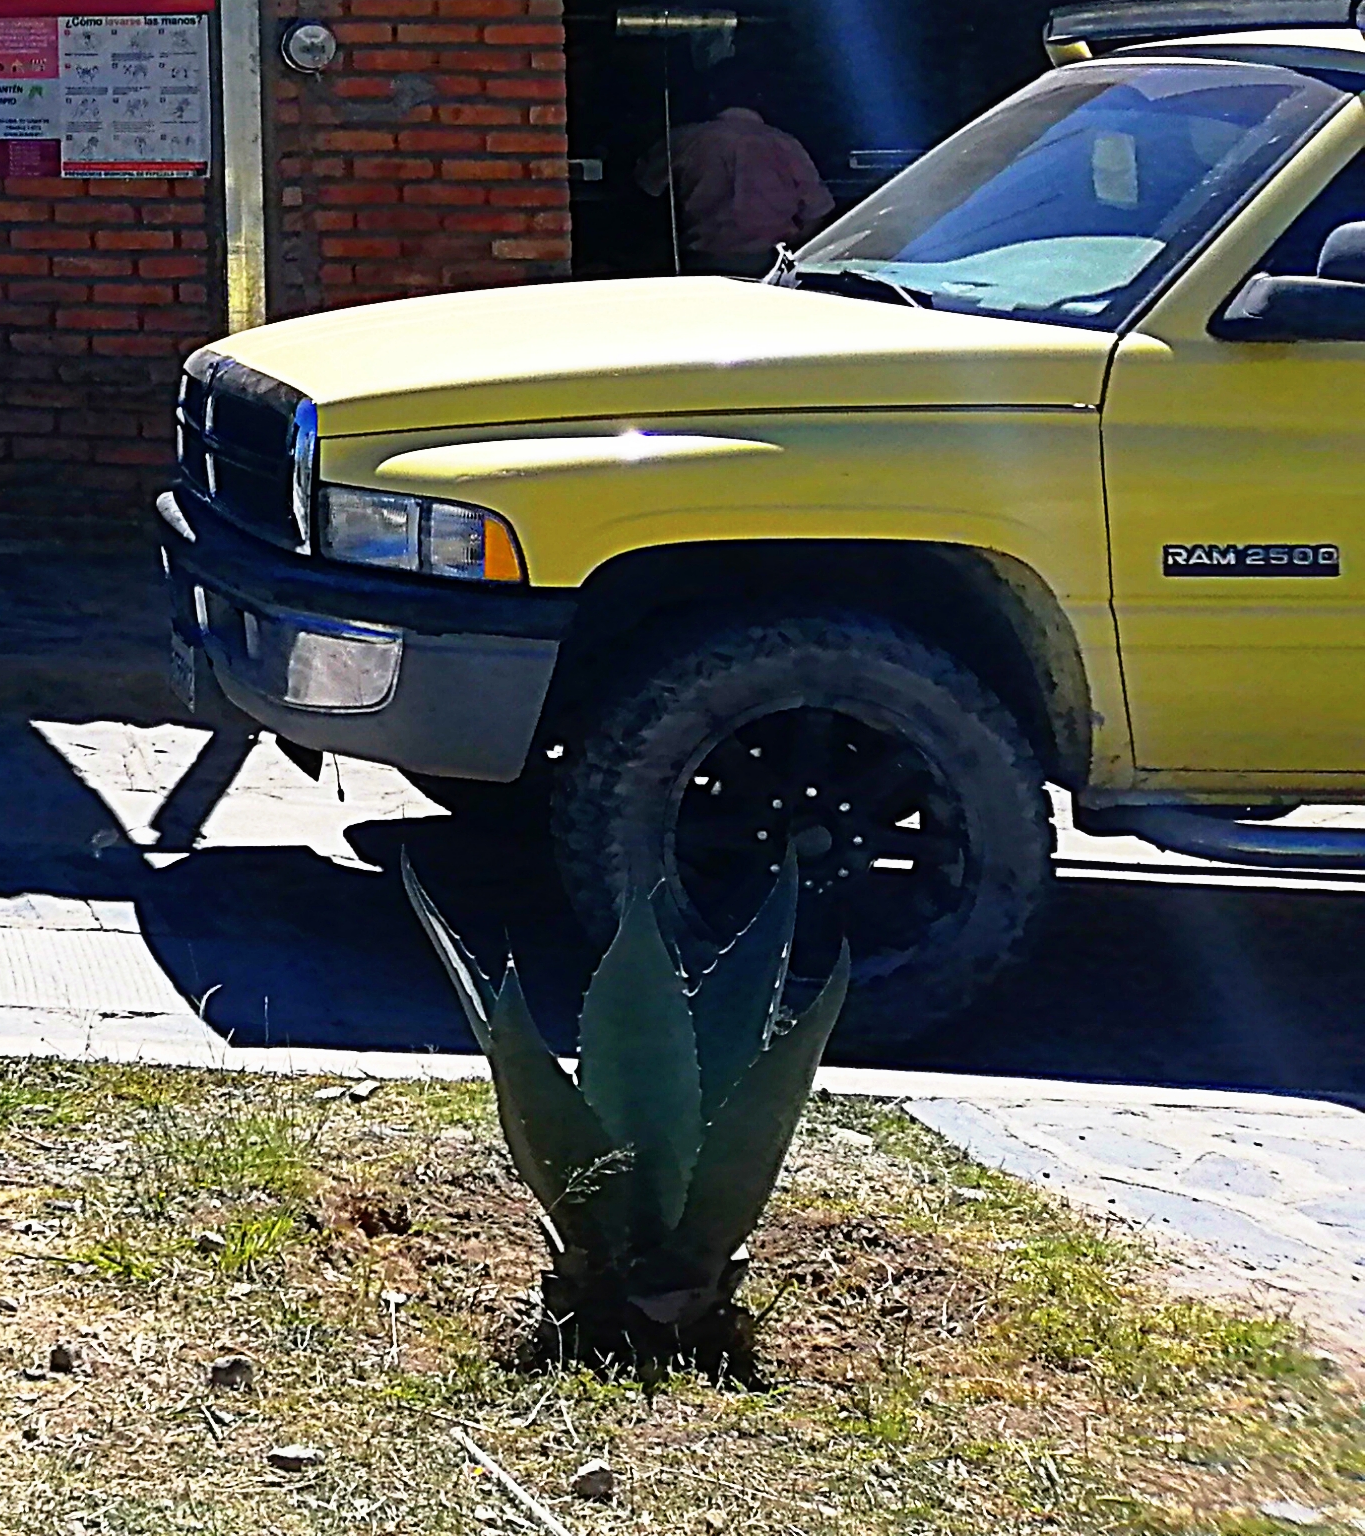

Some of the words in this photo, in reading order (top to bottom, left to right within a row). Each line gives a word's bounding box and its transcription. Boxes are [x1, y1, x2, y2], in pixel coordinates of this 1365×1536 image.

[65, 15, 103, 28] ¿Cómo
[1168, 547, 1237, 565] RAM
[1245, 547, 1338, 565] 2500
